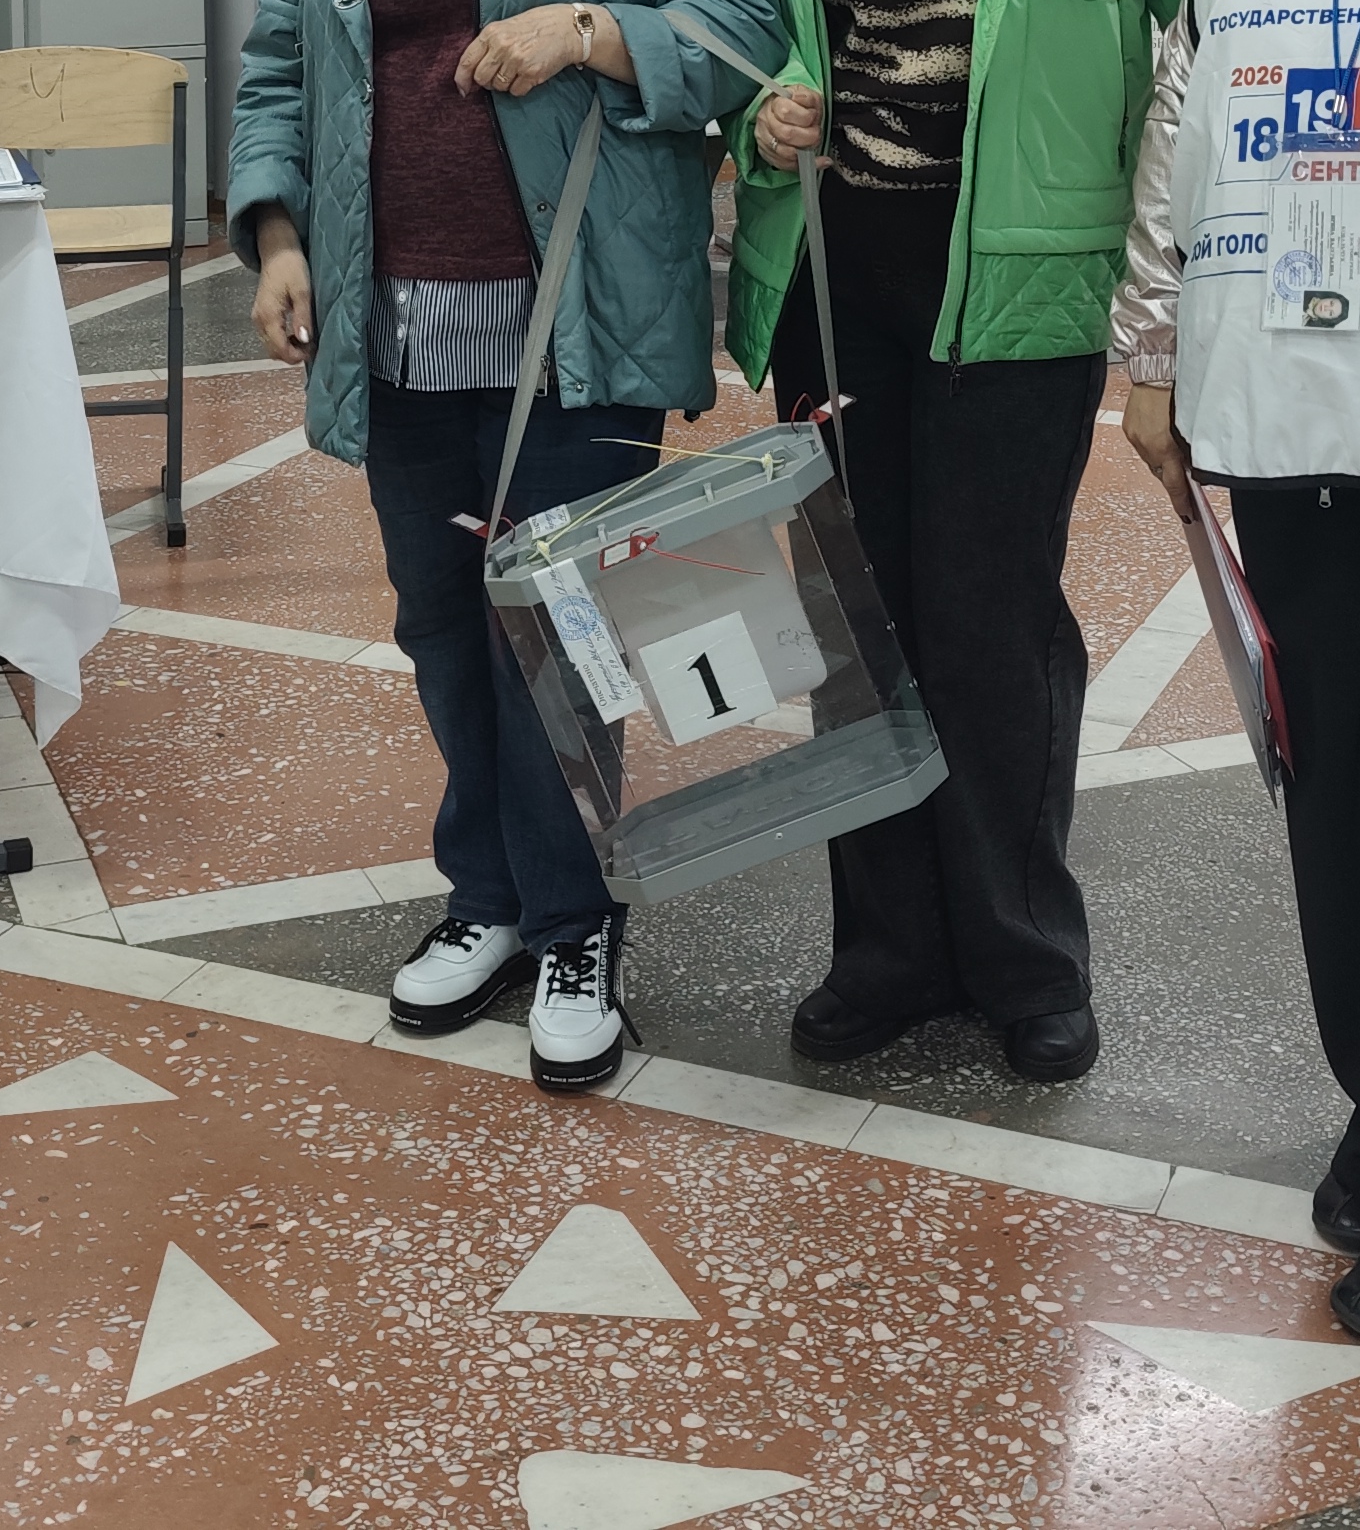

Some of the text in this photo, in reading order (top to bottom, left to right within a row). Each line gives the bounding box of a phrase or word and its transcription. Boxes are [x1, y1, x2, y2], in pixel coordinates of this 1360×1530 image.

[1230, 66, 1283, 87] 2026
[1234, 117, 1279, 163] 18
[1292, 89, 1350, 134] 19
[1217, 233, 1268, 257] ГОЛО
[582, 663, 607, 707] Опечатано
[687, 652, 738, 720] 1
